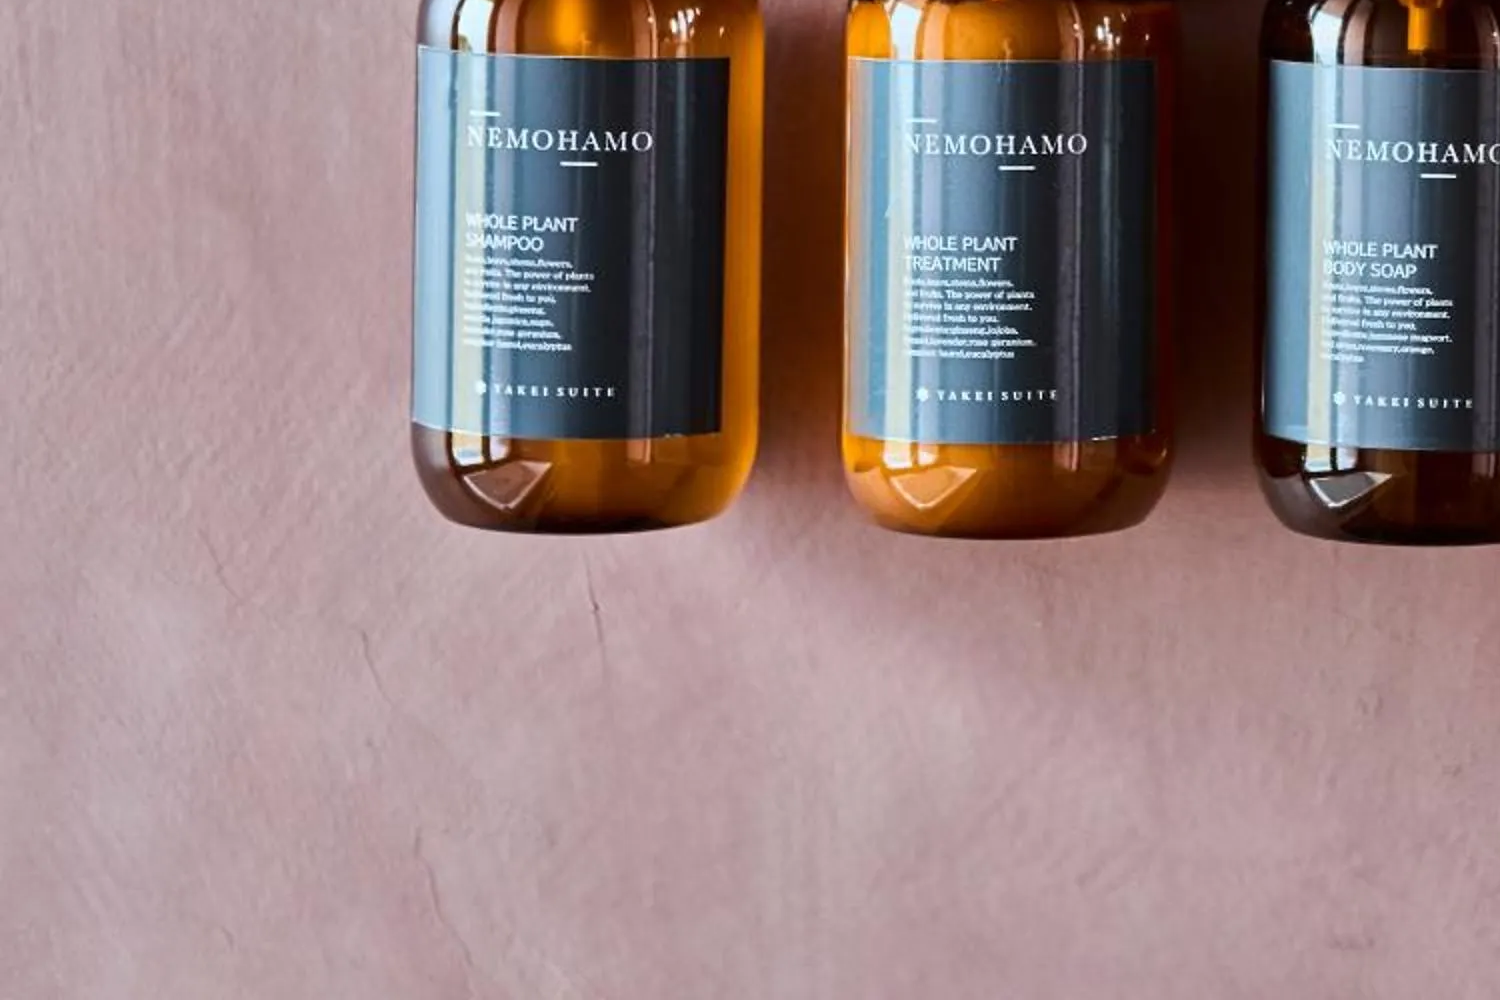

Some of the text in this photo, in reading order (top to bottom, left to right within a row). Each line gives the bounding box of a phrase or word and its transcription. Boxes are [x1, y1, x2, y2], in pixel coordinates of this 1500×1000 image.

[468, 125, 653, 152] NEMOHAMO
[904, 133, 1088, 155] NEMOHAMO
[465, 213, 579, 233] WHOLE PLANT
[465, 232, 545, 251] SHAMPOO
[904, 236, 1018, 252] WHOLE PLANT
[1323, 240, 1438, 260] WHOLE PLANT
[904, 255, 1002, 273] TREATMENT
[1323, 259, 1417, 279] BODY SOAP
[556, 386, 616, 398] SUITE
[1000, 389, 1059, 401] SUITE
[1416, 396, 1474, 409] SUITE
